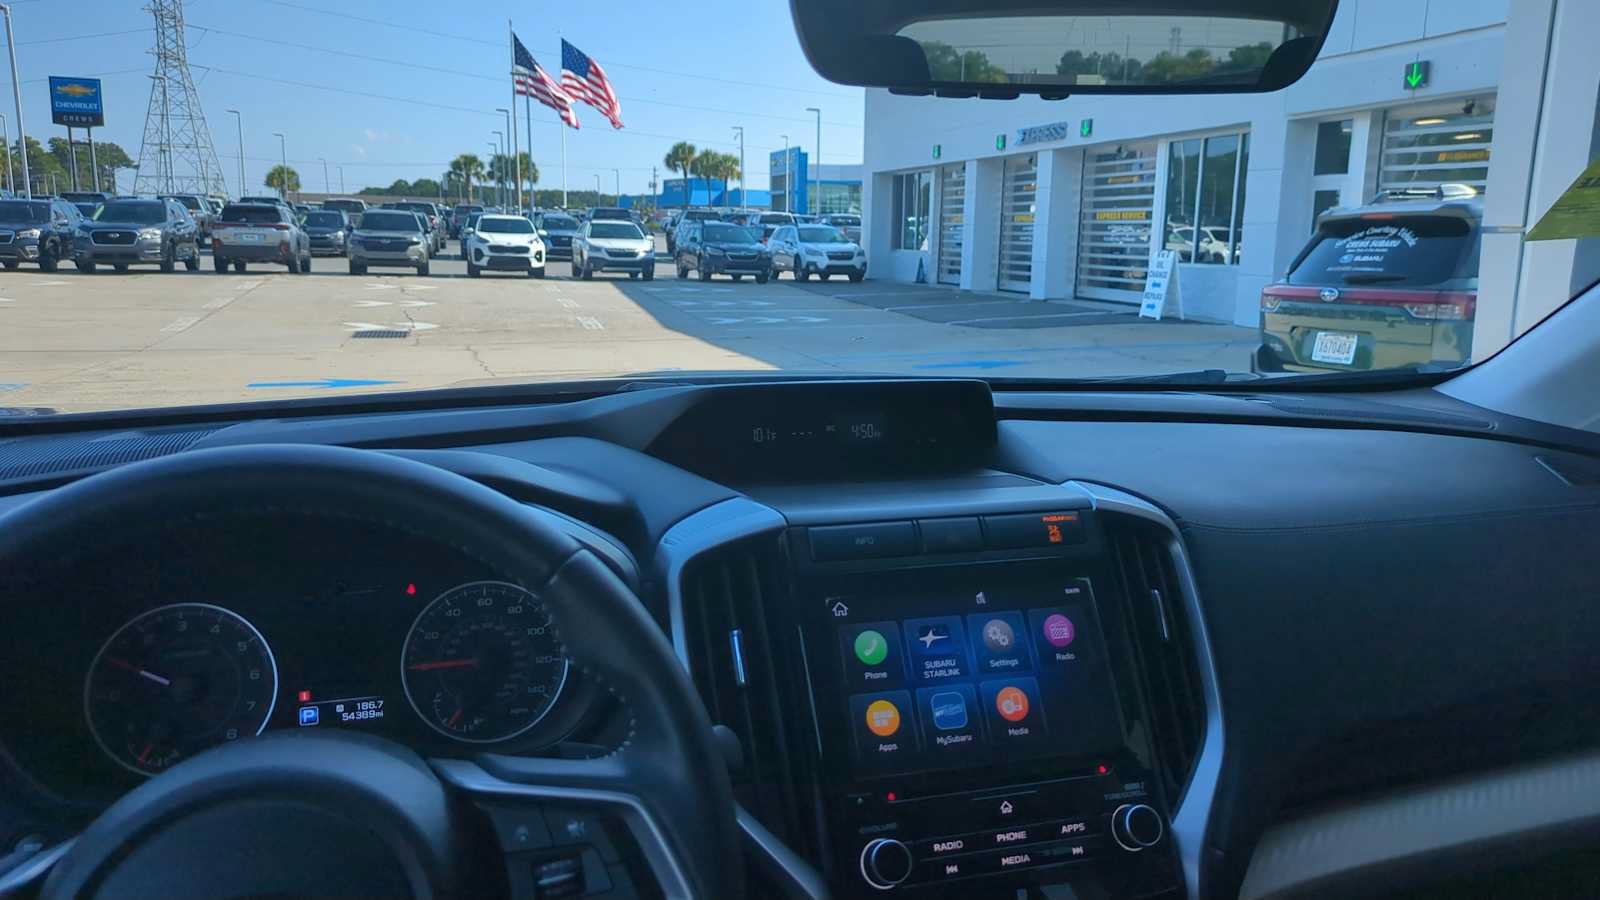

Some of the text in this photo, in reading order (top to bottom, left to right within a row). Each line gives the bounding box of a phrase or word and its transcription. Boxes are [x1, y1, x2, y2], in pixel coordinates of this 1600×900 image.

[55, 101, 98, 110] CHEVROLET
[477, 598, 493, 607] 60
[445, 608, 462, 617] 40
[1056, 652, 1076, 661] Radio
[924, 659, 956, 670] SUBARU
[989, 657, 1019, 669] Settings
[864, 671, 888, 680] Phone
[924, 668, 960, 679] STARLINK
[356, 700, 384, 710] 186.7
[1008, 727, 1029, 736] Media
[936, 734, 973, 746] MySubaru
[879, 743, 898, 752] Apps
[1061, 823, 1085, 834] APPS
[996, 831, 1028, 843] PHONE
[934, 840, 964, 853] RADIO
[1001, 854, 1031, 866] MEDIA
